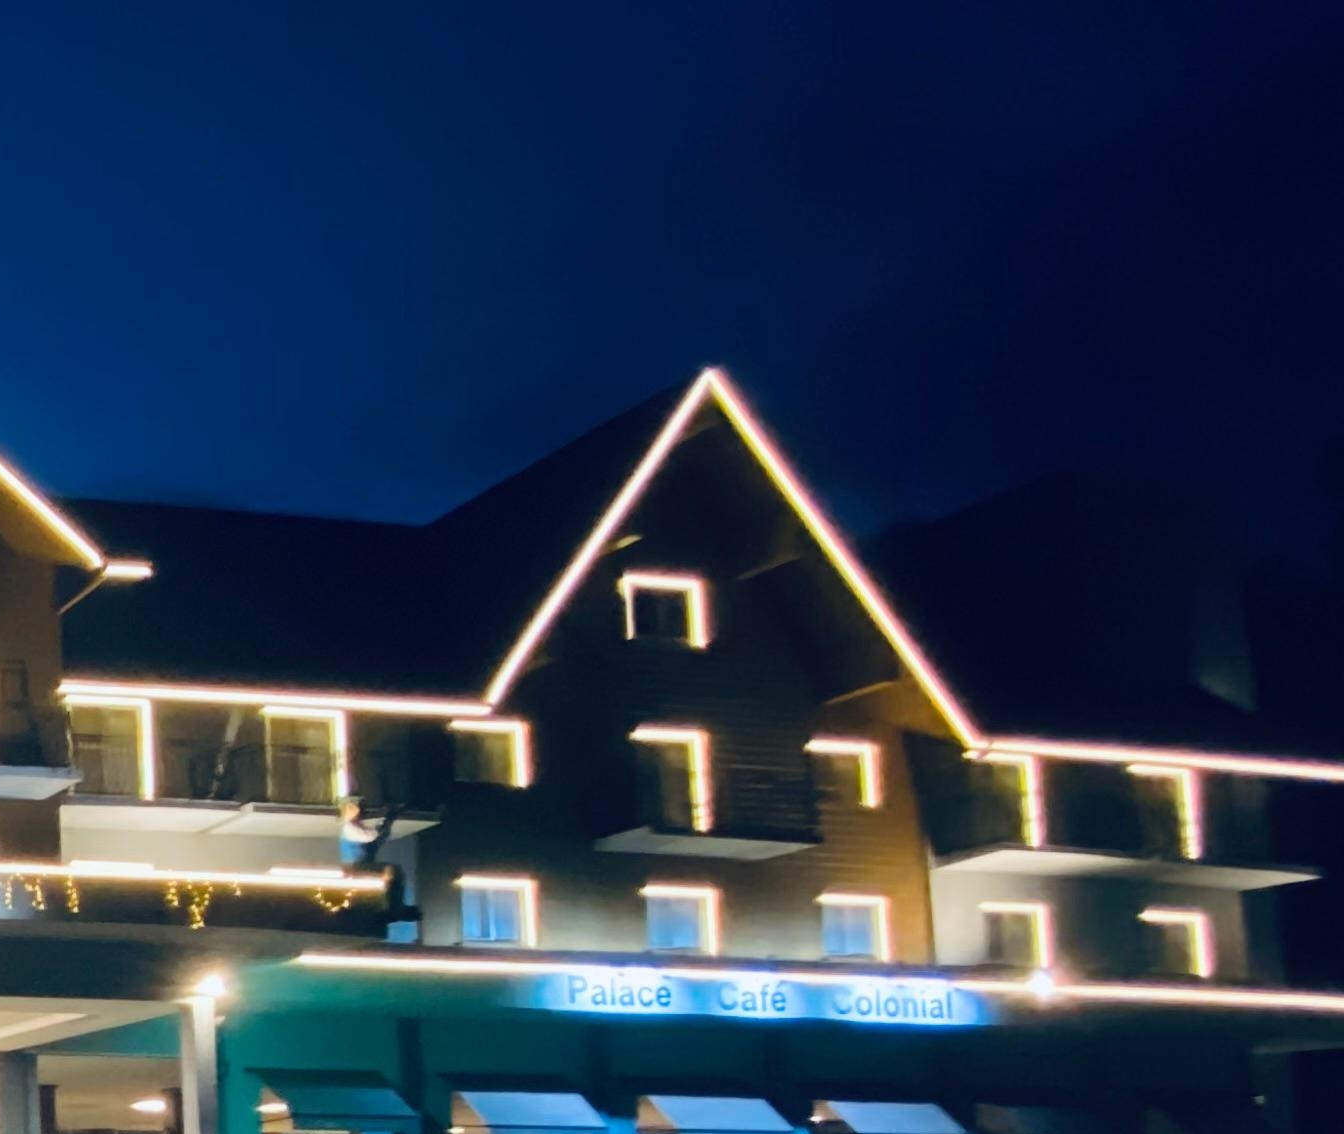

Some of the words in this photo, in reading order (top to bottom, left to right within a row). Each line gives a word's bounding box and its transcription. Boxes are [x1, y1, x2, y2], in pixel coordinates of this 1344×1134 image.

[567, 975, 672, 1008] Palace
[717, 979, 788, 1013] Café
[831, 985, 954, 1021] Colonial
